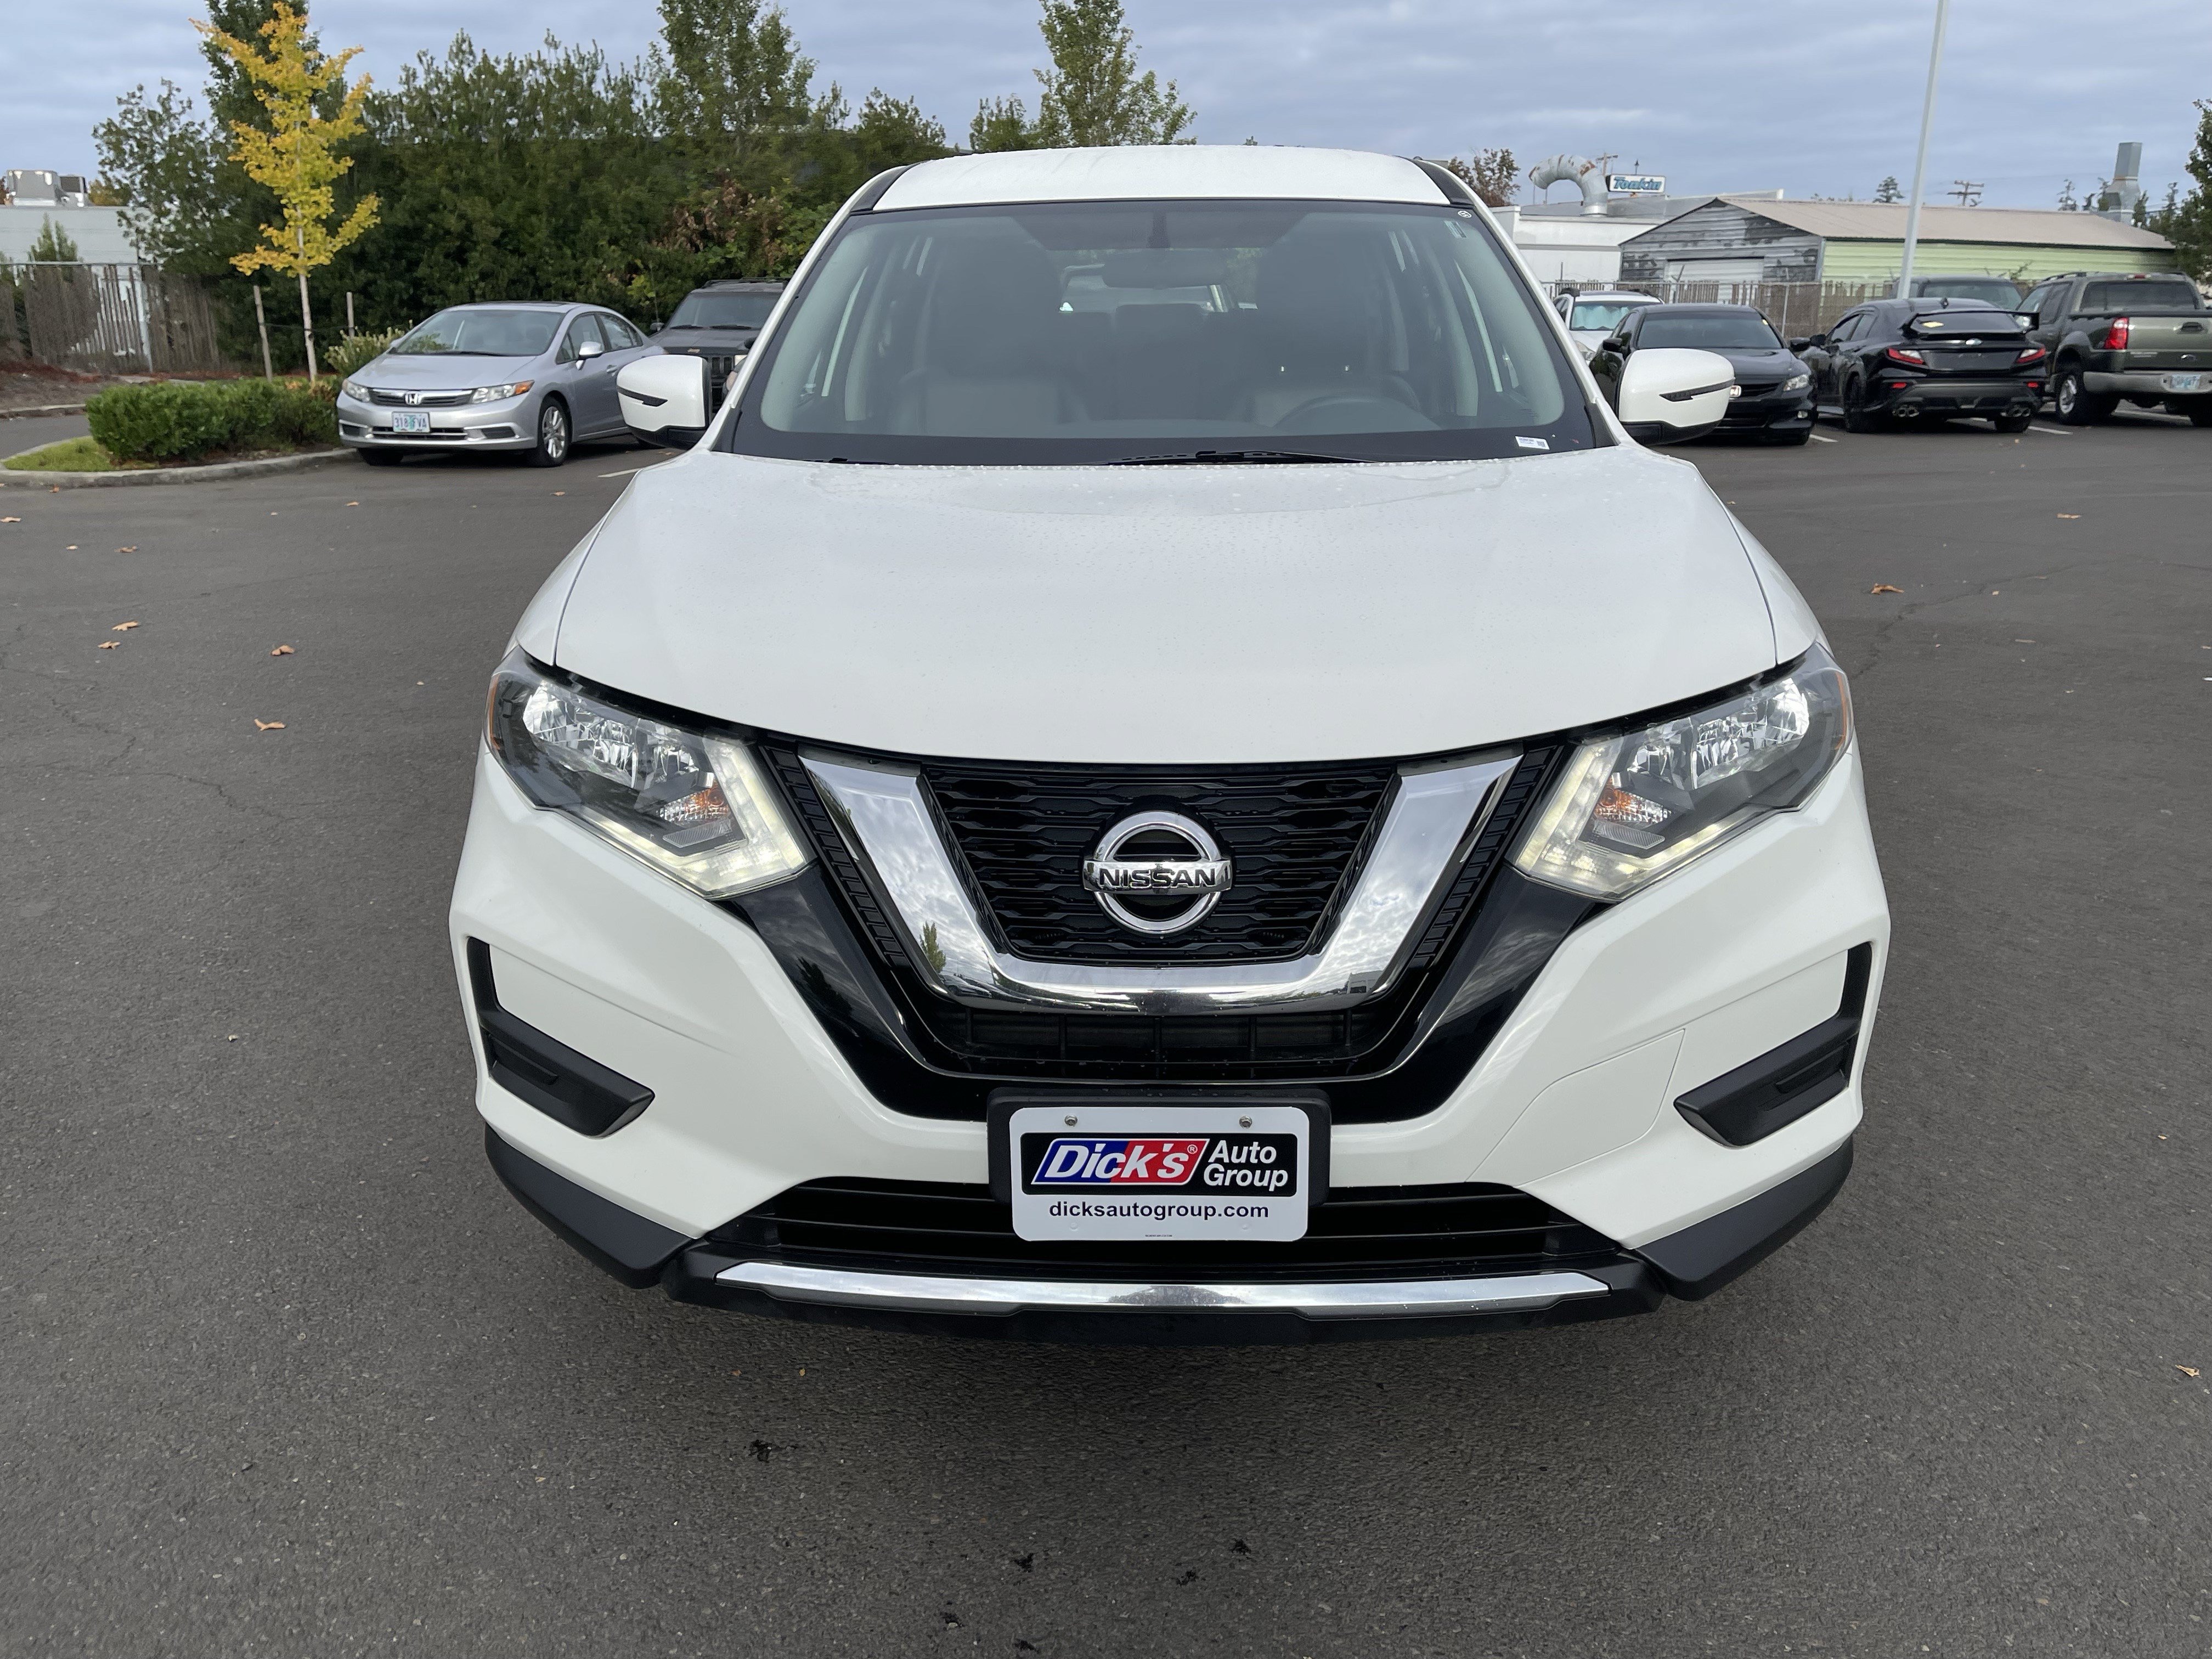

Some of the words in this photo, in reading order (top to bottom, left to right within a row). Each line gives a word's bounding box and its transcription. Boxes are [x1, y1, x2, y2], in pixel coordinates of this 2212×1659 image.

[1099, 868, 1216, 889] NISSAN
[1044, 1143, 1189, 1179] Dick's
[1208, 1140, 1277, 1164] Auto
[1204, 1163, 1288, 1192] Group
[1049, 1201, 1269, 1221] dicksautogroup.com
